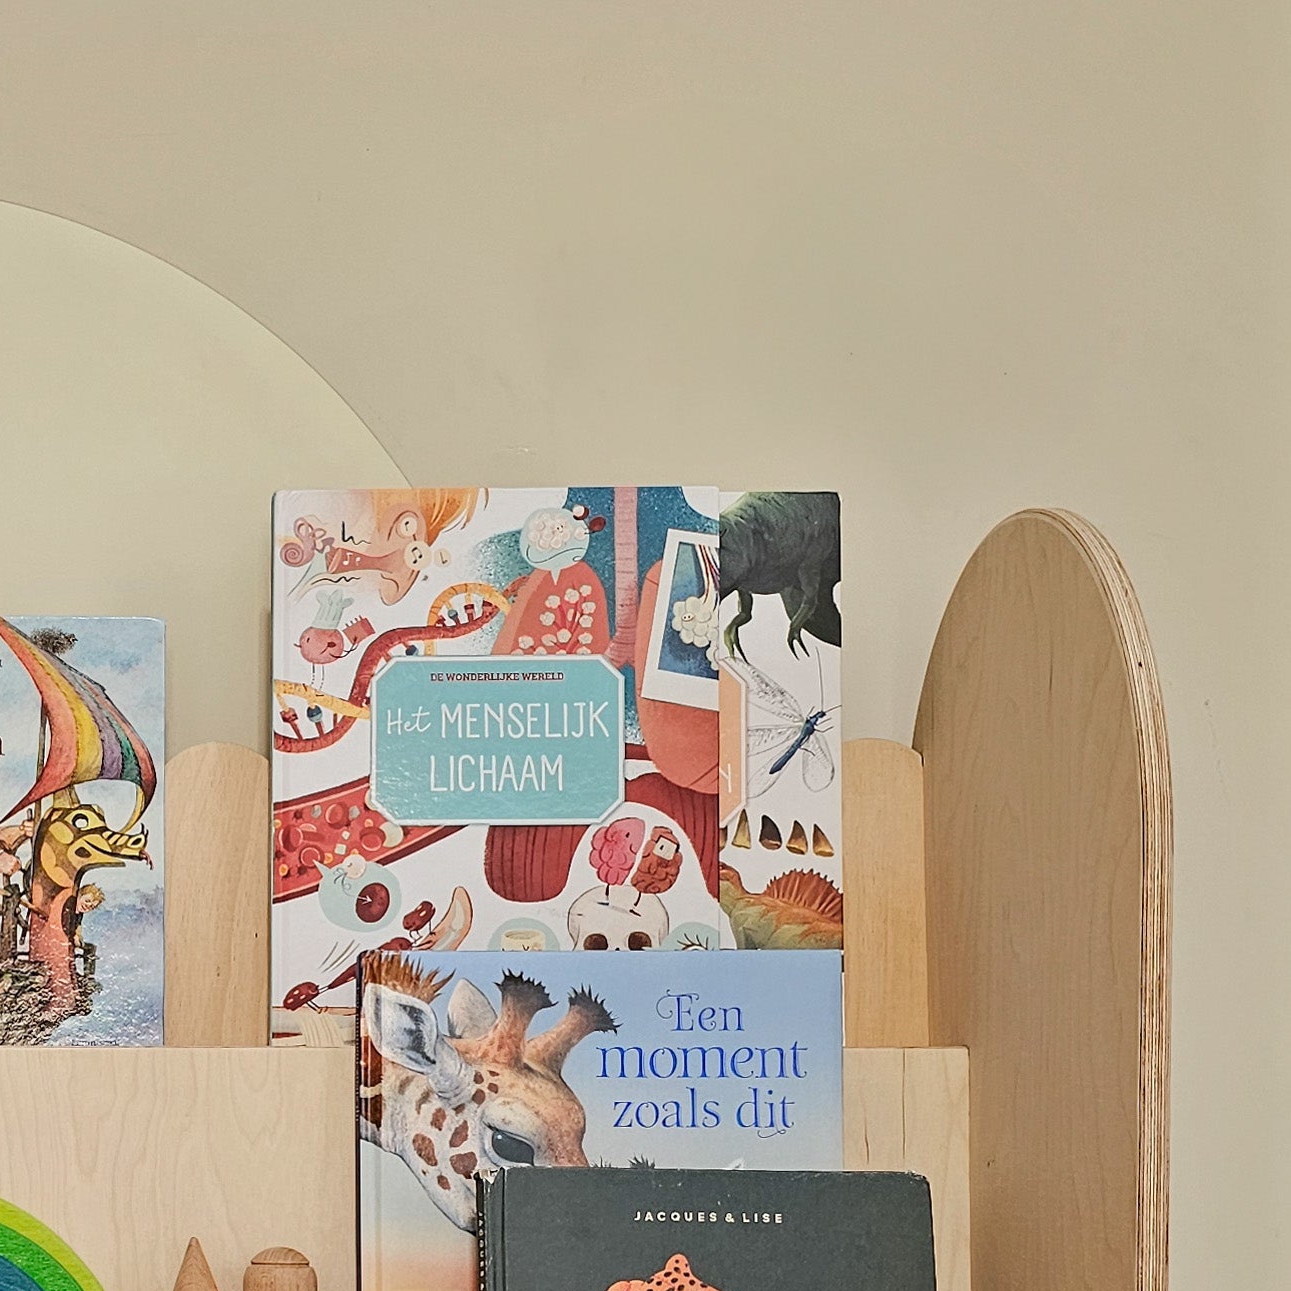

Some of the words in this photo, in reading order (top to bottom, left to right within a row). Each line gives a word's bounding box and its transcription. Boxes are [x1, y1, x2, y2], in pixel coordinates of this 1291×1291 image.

[430, 673, 444, 682] DE
[446, 673, 520, 681] WONDERLIJKE
[521, 672, 564, 681] WERELD
[386, 706, 431, 735] Het
[441, 701, 610, 739] MENSELIJK
[430, 754, 563, 792] LICHAAM
[655, 989, 745, 1032] Een
[596, 1041, 808, 1079] moment
[613, 1087, 721, 1129] zoals
[736, 1087, 796, 1139] dit
[634, 1211, 717, 1222] JACQUES
[724, 1212, 735, 1222] &
[742, 1213, 783, 1224] LISE
